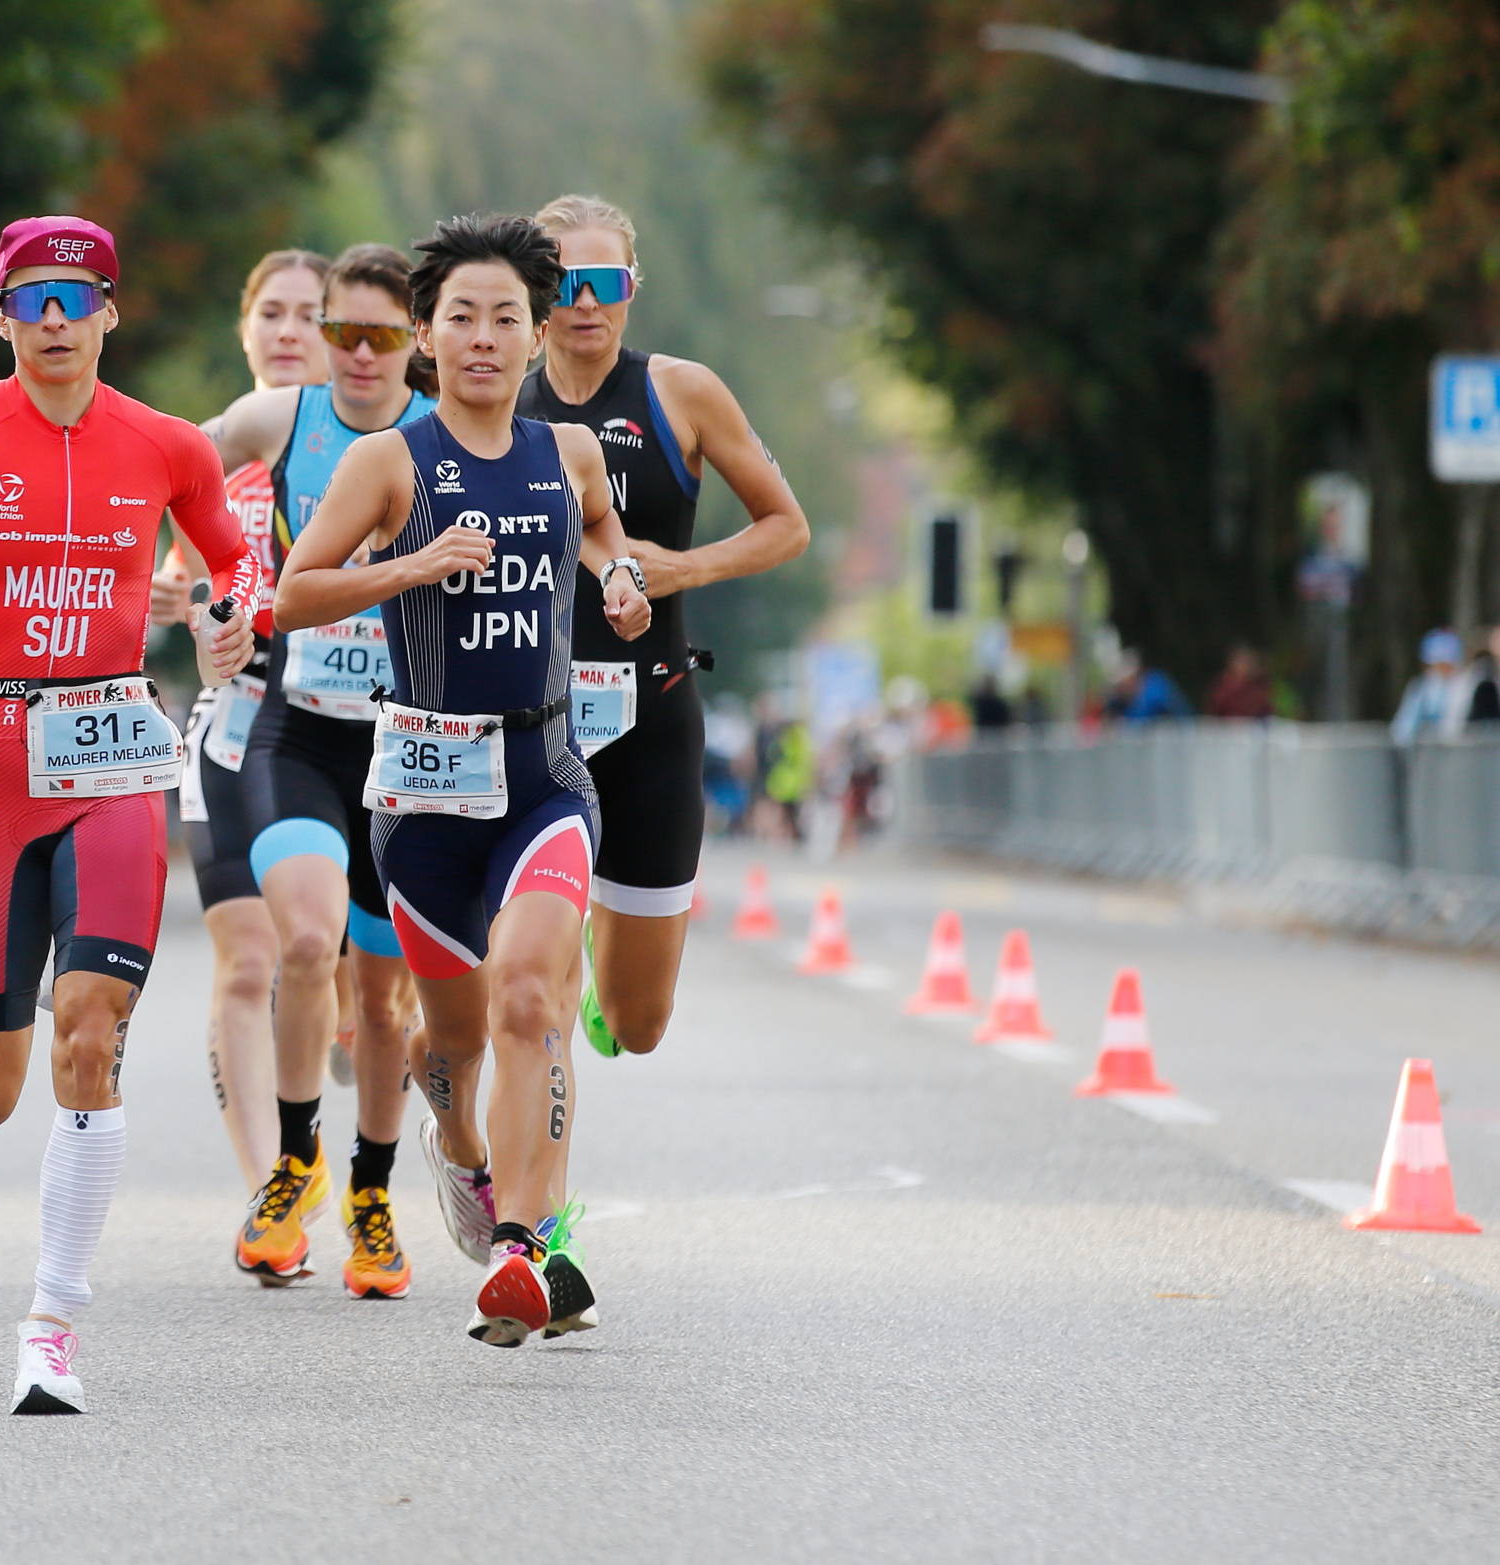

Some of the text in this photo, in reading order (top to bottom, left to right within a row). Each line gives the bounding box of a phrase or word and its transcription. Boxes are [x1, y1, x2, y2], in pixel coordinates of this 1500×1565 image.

[47, 237, 95, 251] KEEP
[55, 251, 84, 263] ON!
[598, 430, 643, 449] skinfit
[528, 481, 562, 491] HUUB
[498, 515, 549, 534] NTT
[25, 531, 109, 544] impuls.ch
[441, 554, 555, 594] UEDA
[4, 566, 116, 610] MAURER
[23, 615, 90, 658] SUI
[460, 610, 538, 650] JPN
[324, 647, 387, 675] 40 F
[580, 670, 604, 684] MAN
[58, 689, 100, 707] POWER
[125, 684, 145, 700] MAN
[582, 702, 594, 720] F
[75, 713, 146, 746] 31 F
[393, 713, 423, 732] POWER
[443, 720, 469, 736] MAN
[47, 743, 172, 768] MAURER MELANIE
[401, 740, 461, 773] 36 F
[403, 775, 456, 789] UEDA AI
[534, 868, 582, 891] HUUB
[119, 957, 145, 971] iNOW
[551, 1065, 566, 1140] 36
